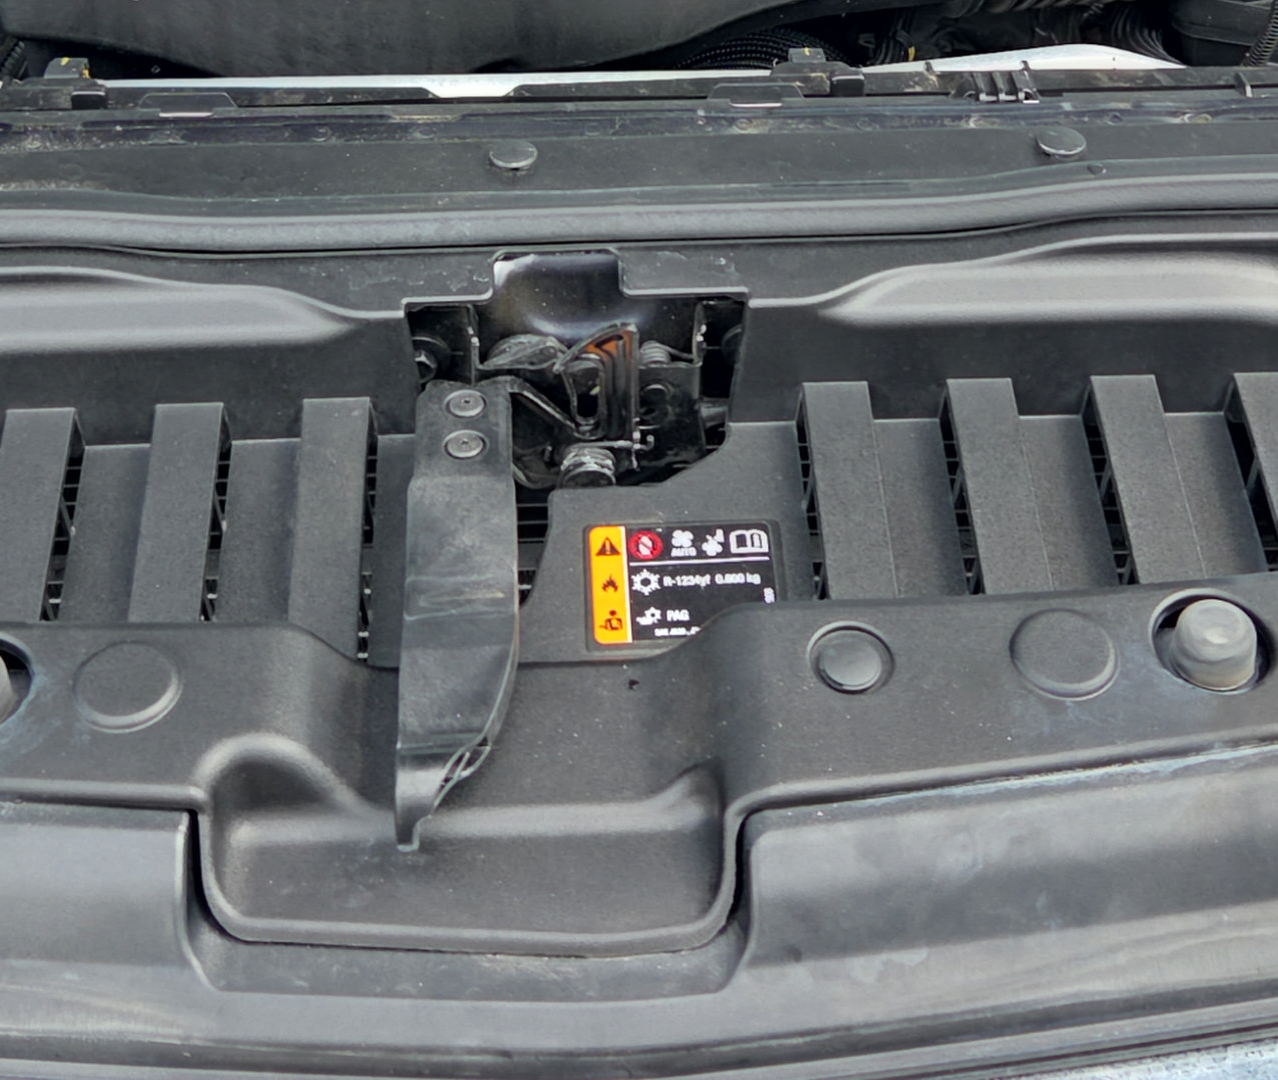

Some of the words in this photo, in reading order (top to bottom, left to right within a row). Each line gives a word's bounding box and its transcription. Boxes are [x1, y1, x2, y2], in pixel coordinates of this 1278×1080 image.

[671, 547, 696, 557] AUTO
[746, 573, 761, 585] kg
[667, 609, 690, 621] PAG
